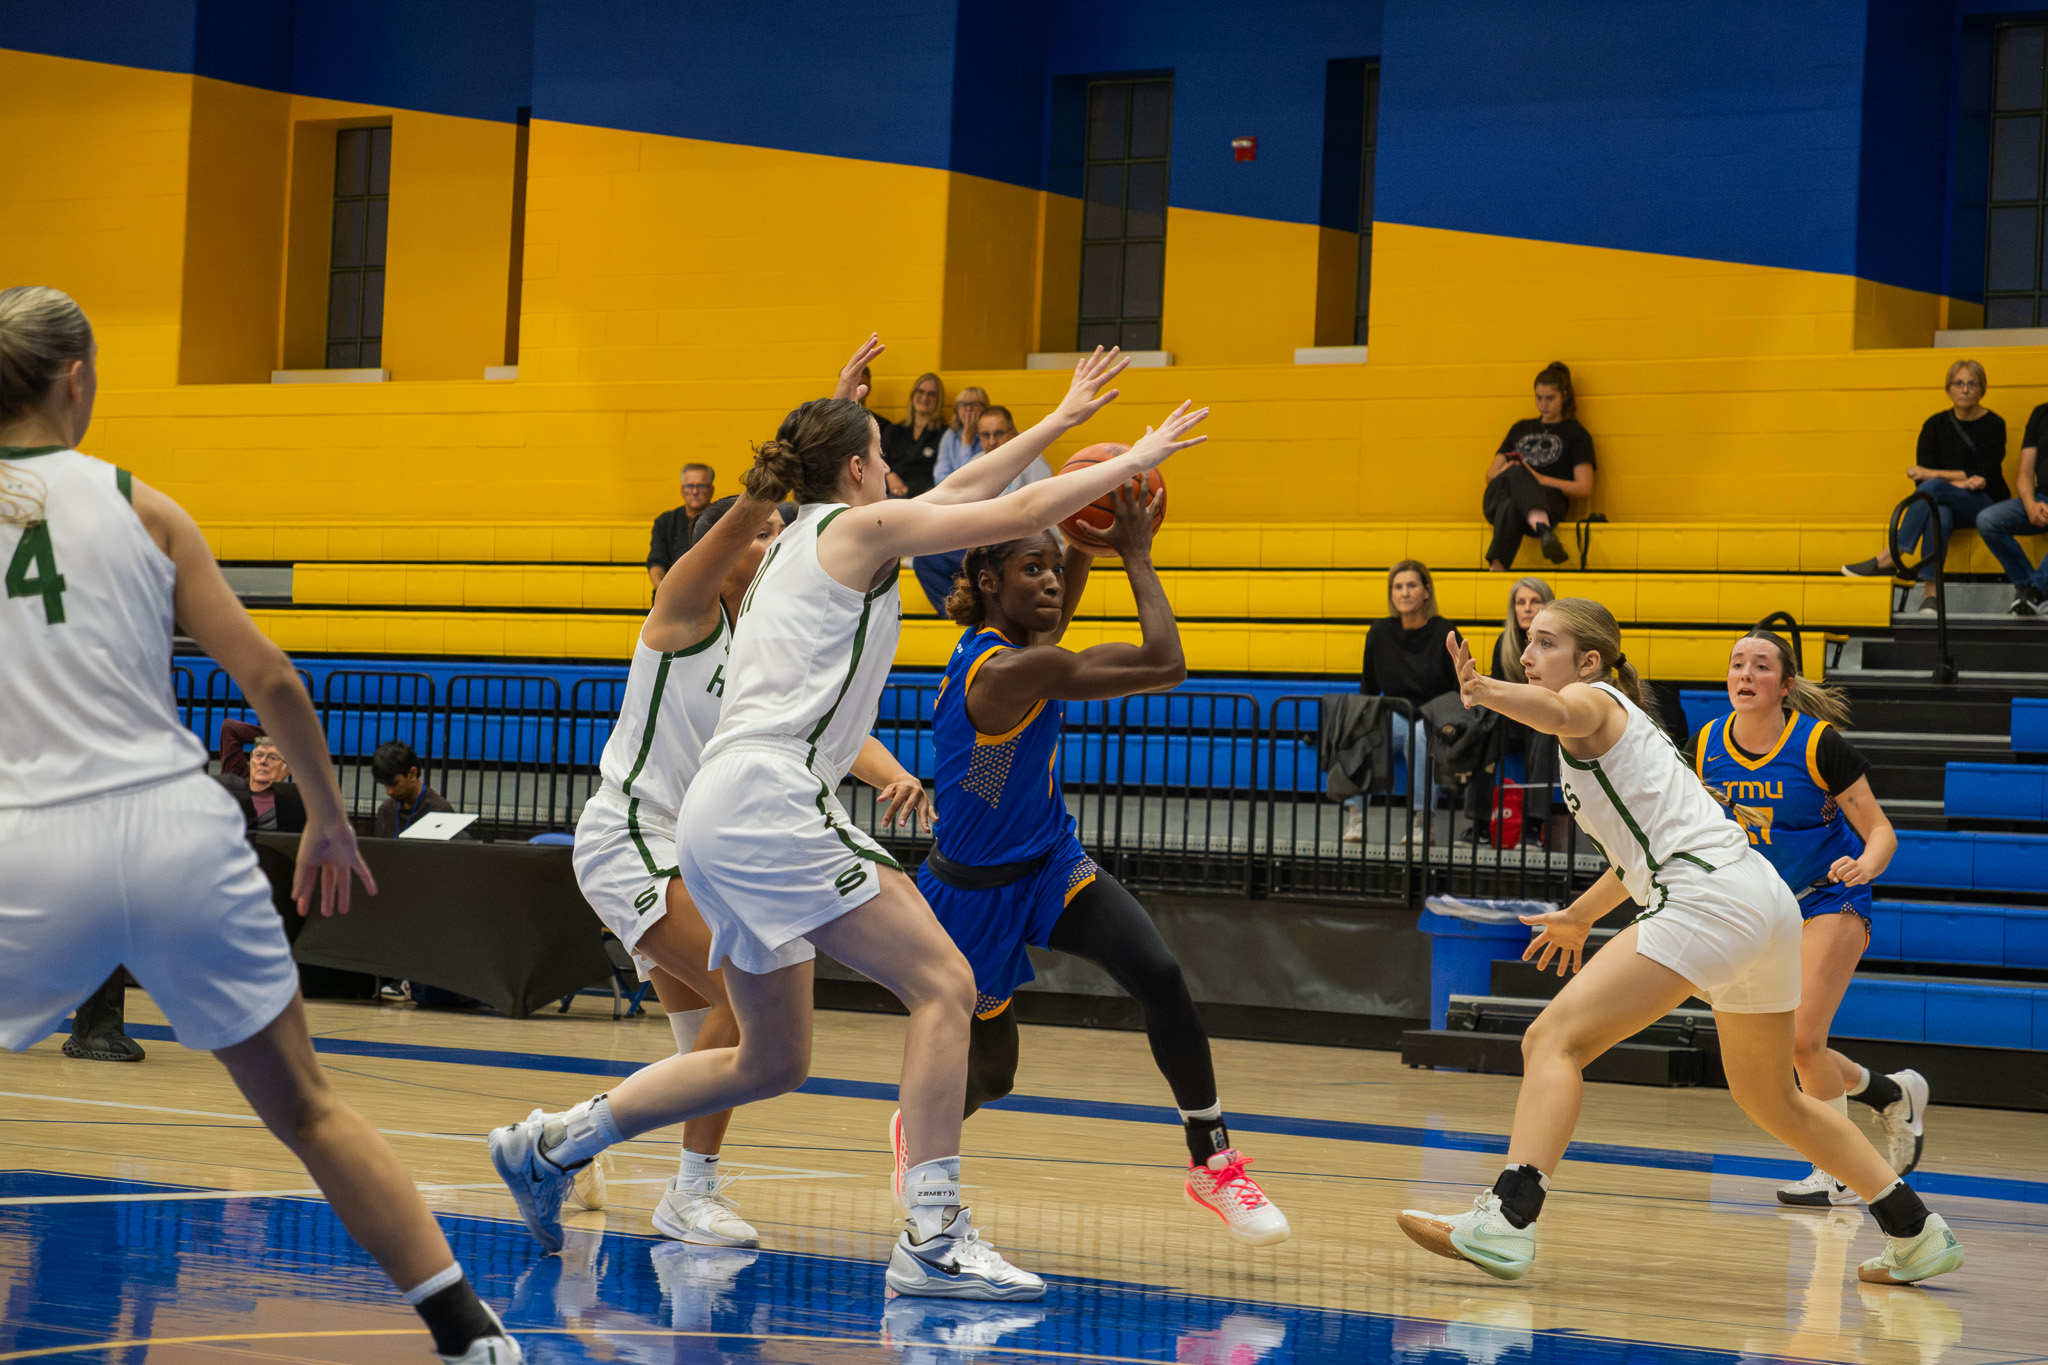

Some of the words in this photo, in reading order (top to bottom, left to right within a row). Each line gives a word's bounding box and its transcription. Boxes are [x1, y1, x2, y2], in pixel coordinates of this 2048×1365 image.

[5, 519, 67, 626] 4
[1722, 781, 1784, 799] TMU
[834, 862, 868, 897] S
[633, 885, 659, 917] S
